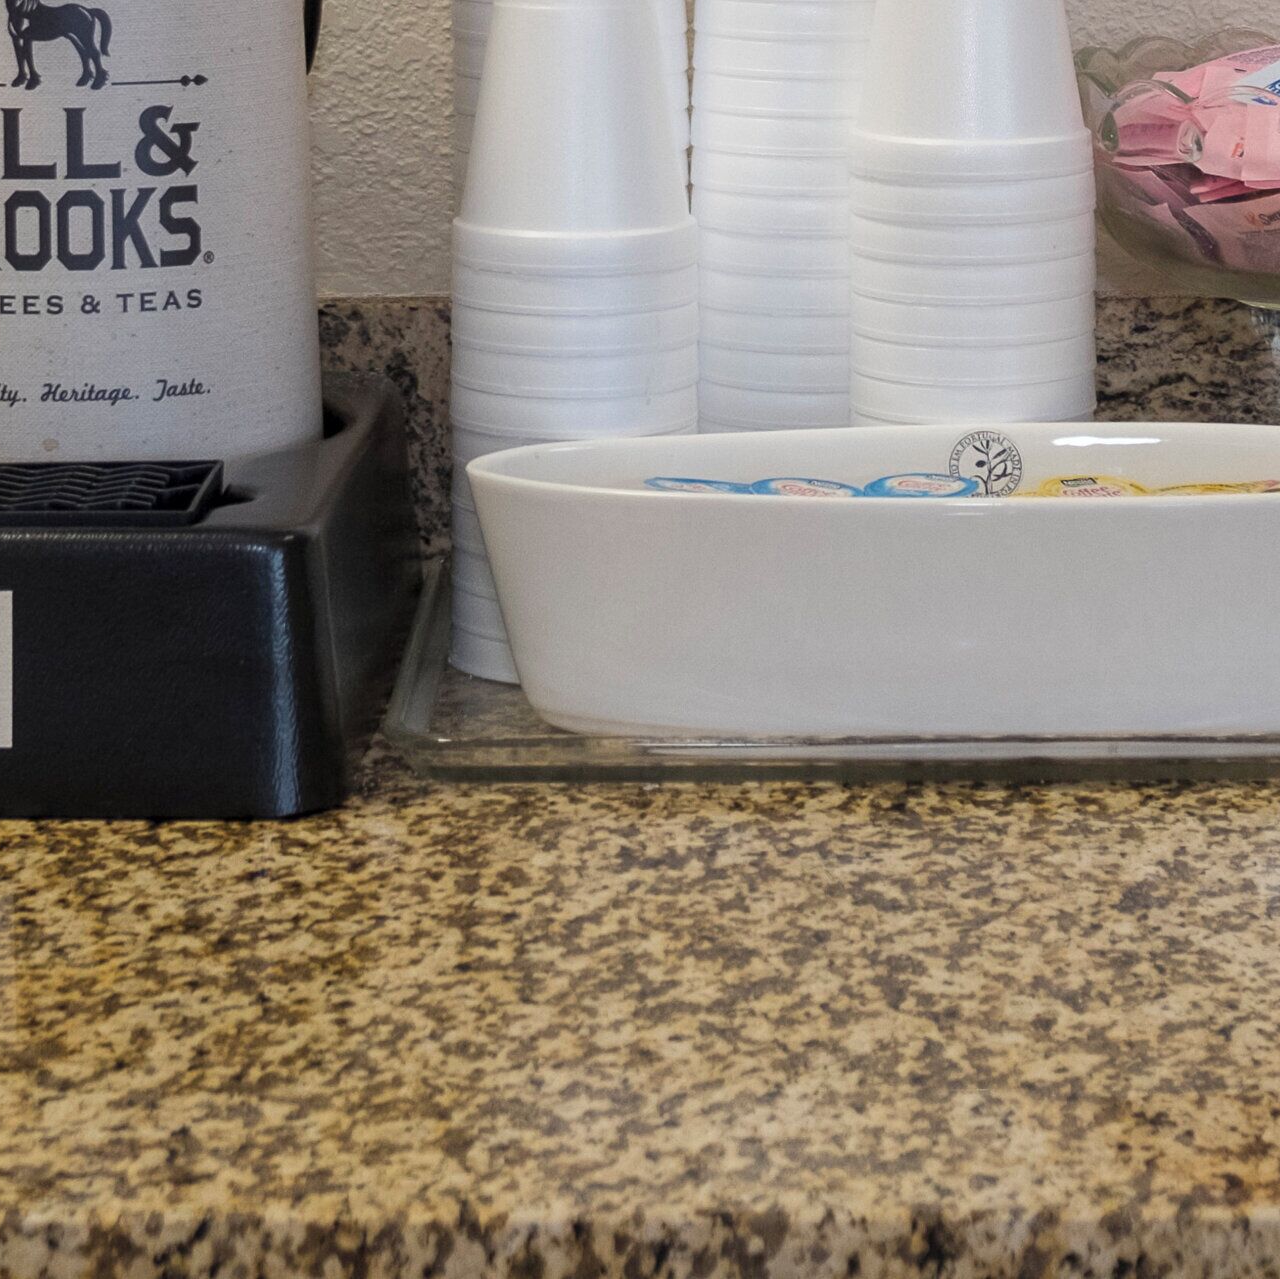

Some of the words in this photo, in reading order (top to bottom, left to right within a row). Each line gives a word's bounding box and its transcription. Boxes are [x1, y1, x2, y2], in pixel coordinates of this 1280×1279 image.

[134, 104, 201, 177] &
[80, 295, 101, 315] &
[117, 288, 203, 313] TEAS
[40, 382, 140, 406] Heritage.
[152, 378, 211, 401] Taste.
